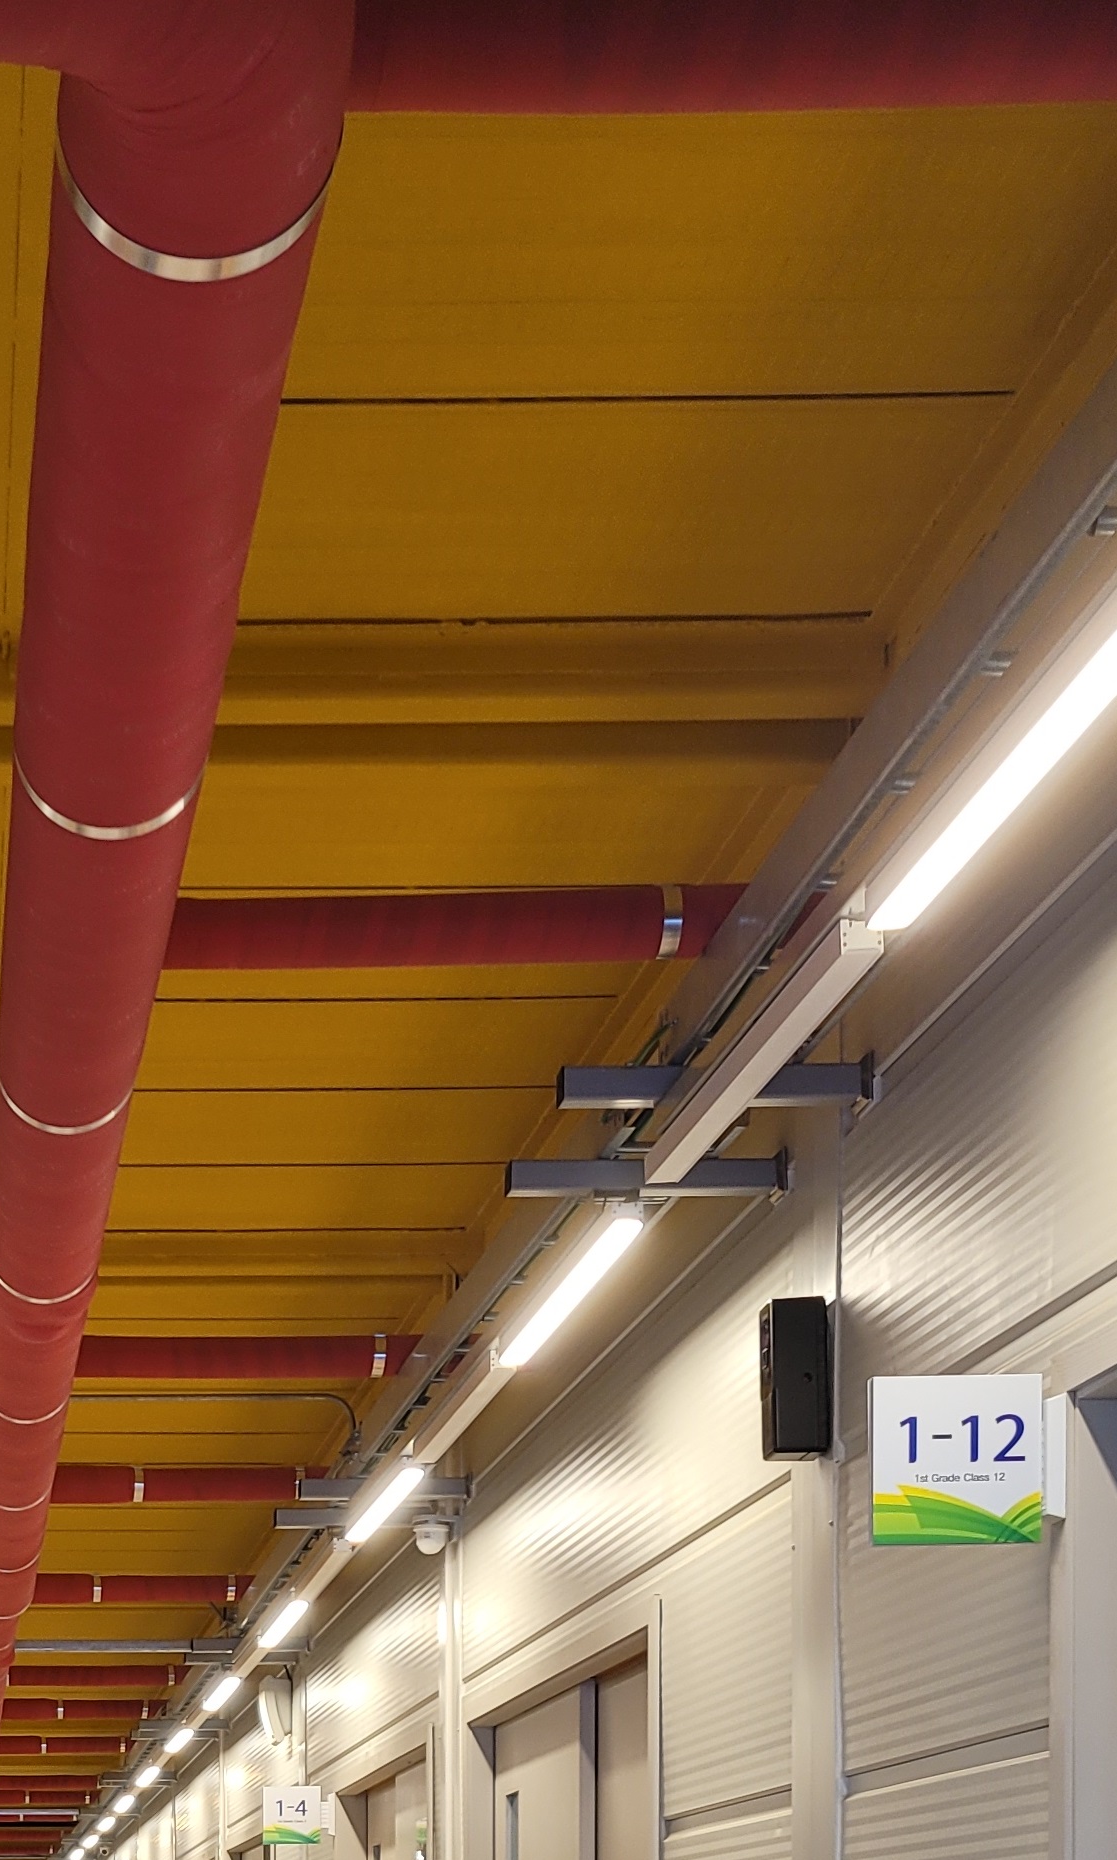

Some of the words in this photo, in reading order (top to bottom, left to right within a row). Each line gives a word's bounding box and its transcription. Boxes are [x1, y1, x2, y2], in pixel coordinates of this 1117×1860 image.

[899, 1413, 1026, 1464] 1-12
[914, 1474, 929, 1483] 1st
[931, 1473, 961, 1483] Grade
[964, 1472, 990, 1482] Class
[994, 1472, 1006, 1482] 12
[275, 1799, 309, 1817] 1-4
